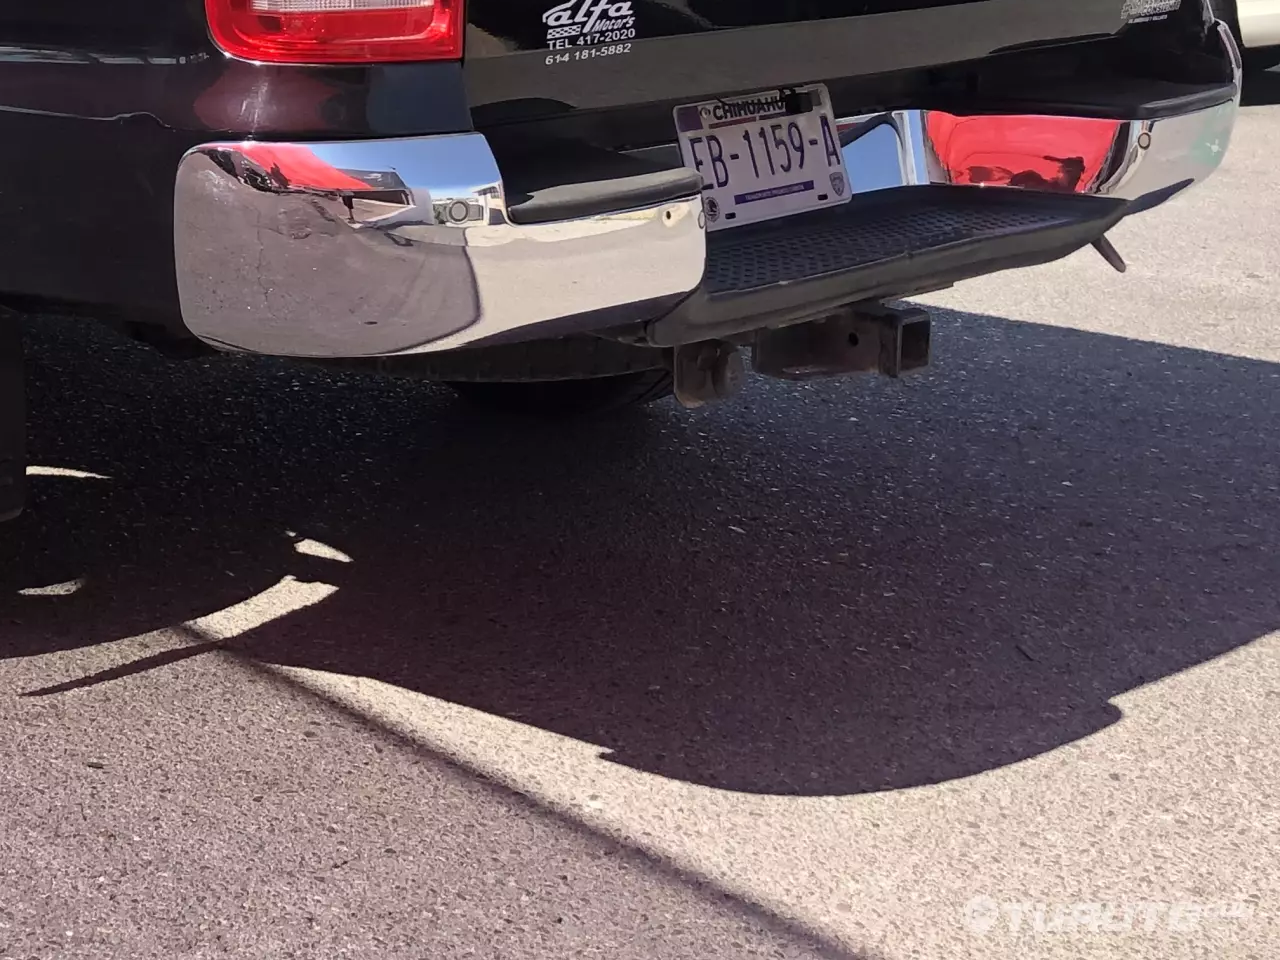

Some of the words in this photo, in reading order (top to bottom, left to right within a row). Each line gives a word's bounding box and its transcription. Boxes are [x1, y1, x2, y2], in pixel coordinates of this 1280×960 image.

[546, 38, 573, 51] TEL
[576, 28, 636, 46] 417-2020
[573, 42, 632, 61] 181-5882
[712, 95, 786, 121] CHIHUAHU
